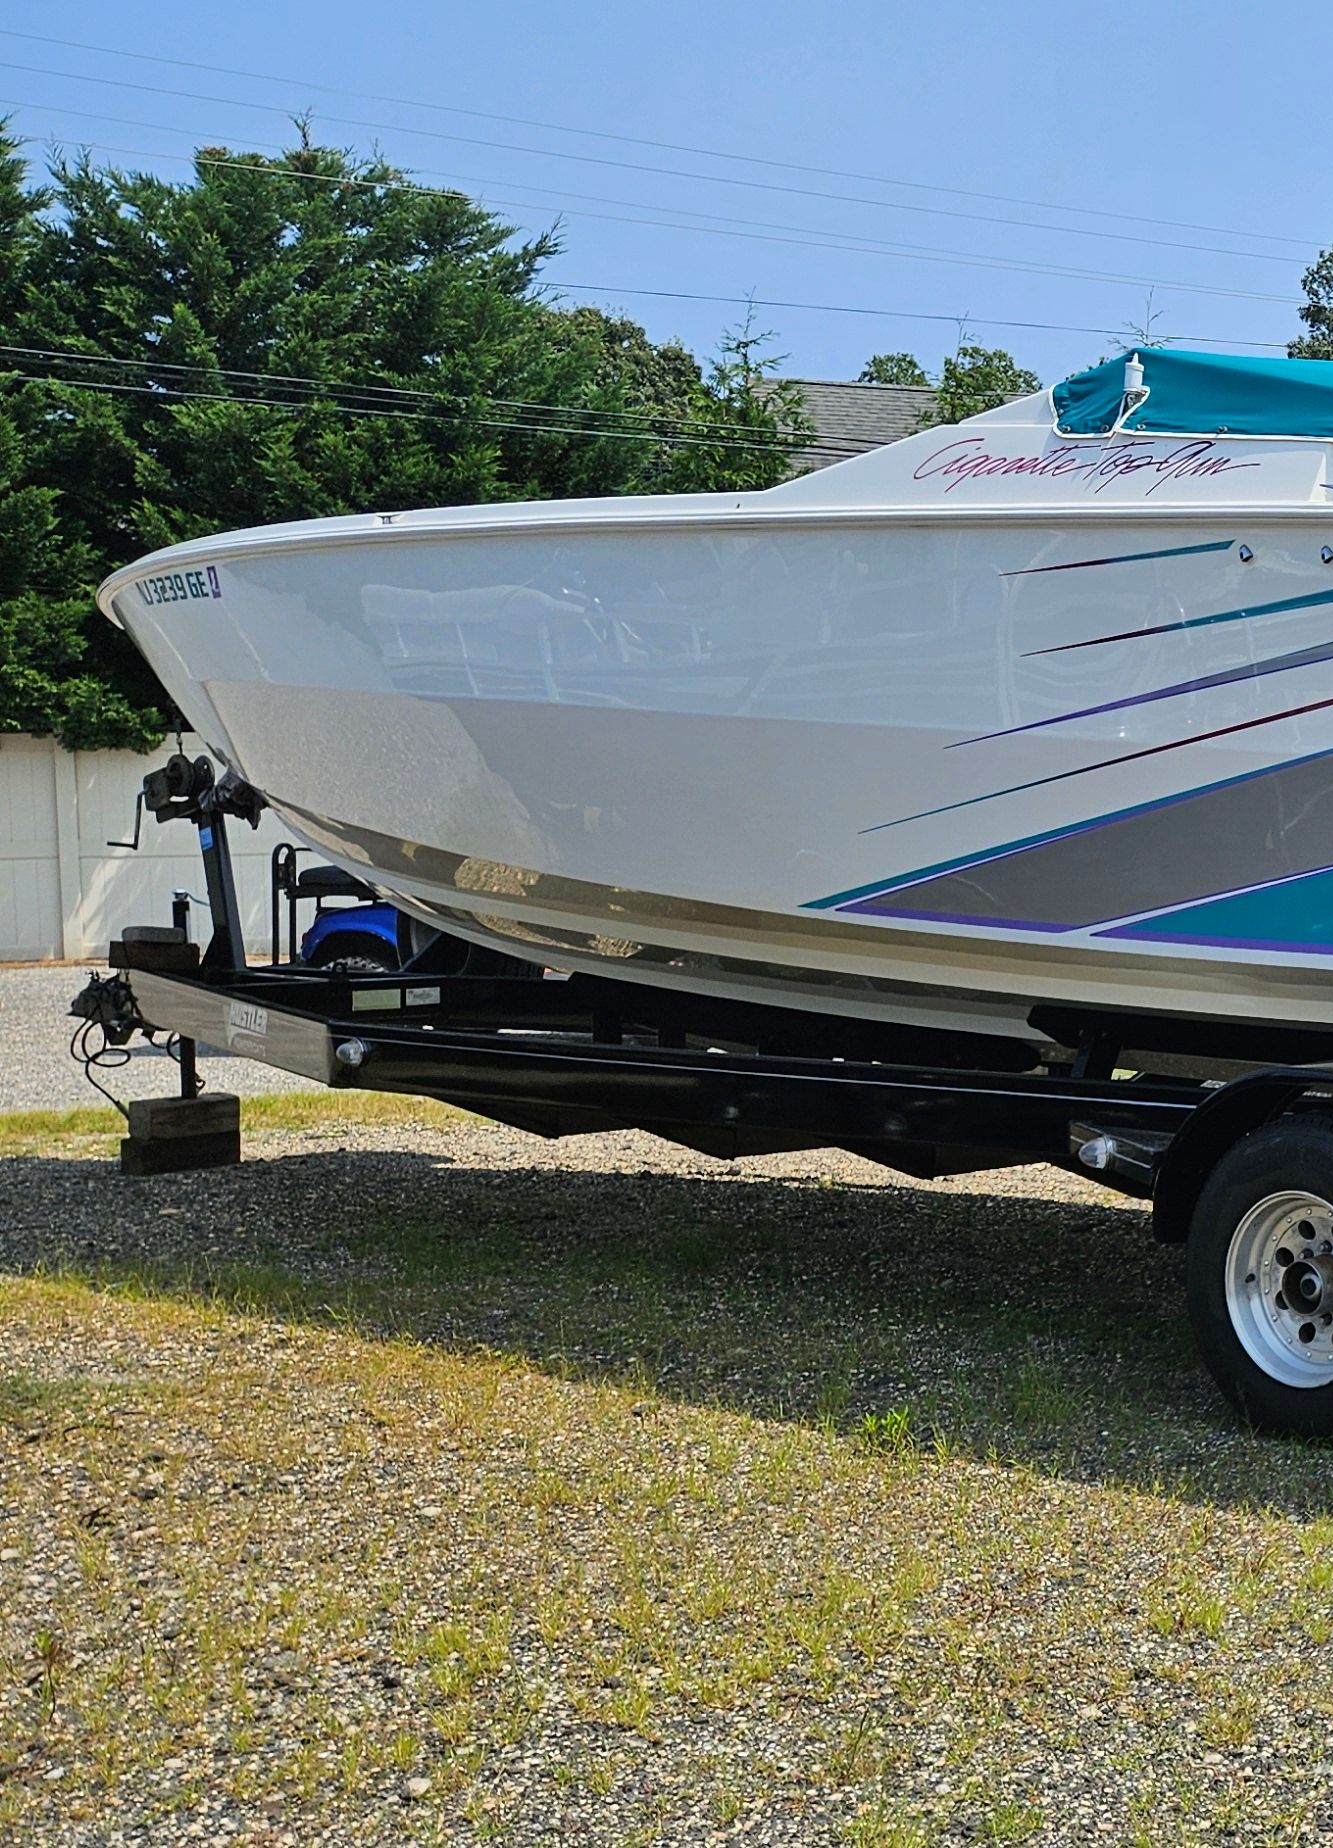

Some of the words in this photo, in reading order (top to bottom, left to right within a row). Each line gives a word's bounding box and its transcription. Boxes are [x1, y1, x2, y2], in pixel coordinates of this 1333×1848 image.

[914, 438, 1102, 493] Cigarette
[1083, 441, 1160, 494] Top
[149, 574, 188, 604] 3239
[185, 571, 210, 598] GE
